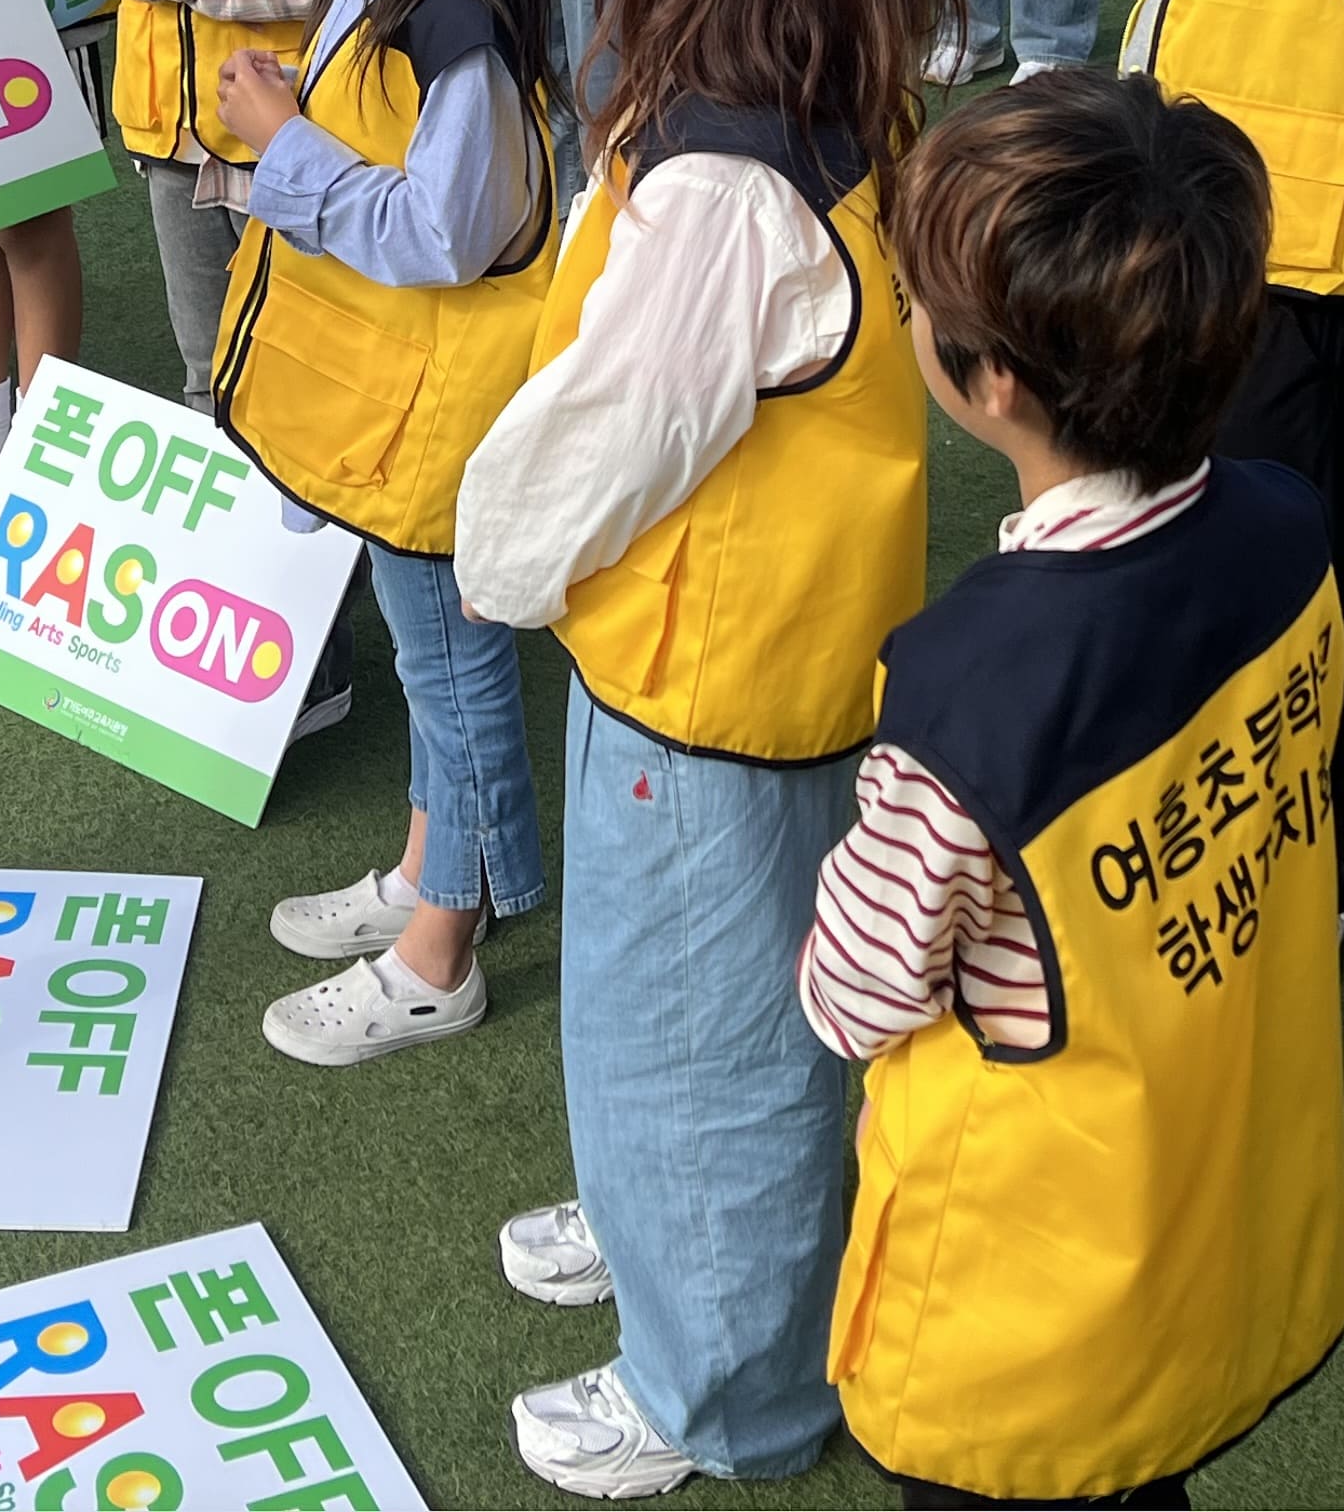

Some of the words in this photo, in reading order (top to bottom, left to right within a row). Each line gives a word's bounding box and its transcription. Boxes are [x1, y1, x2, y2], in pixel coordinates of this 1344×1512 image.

[24, 385, 105, 487] 폰
[98, 420, 251, 532] OFF
[27, 618, 64, 647] Arts
[67, 635, 122, 674] Sports
[158, 589, 262, 684] ON
[54, 892, 171, 947] 폰
[26, 958, 148, 1096] OFF
[128, 1260, 280, 1353] 폰
